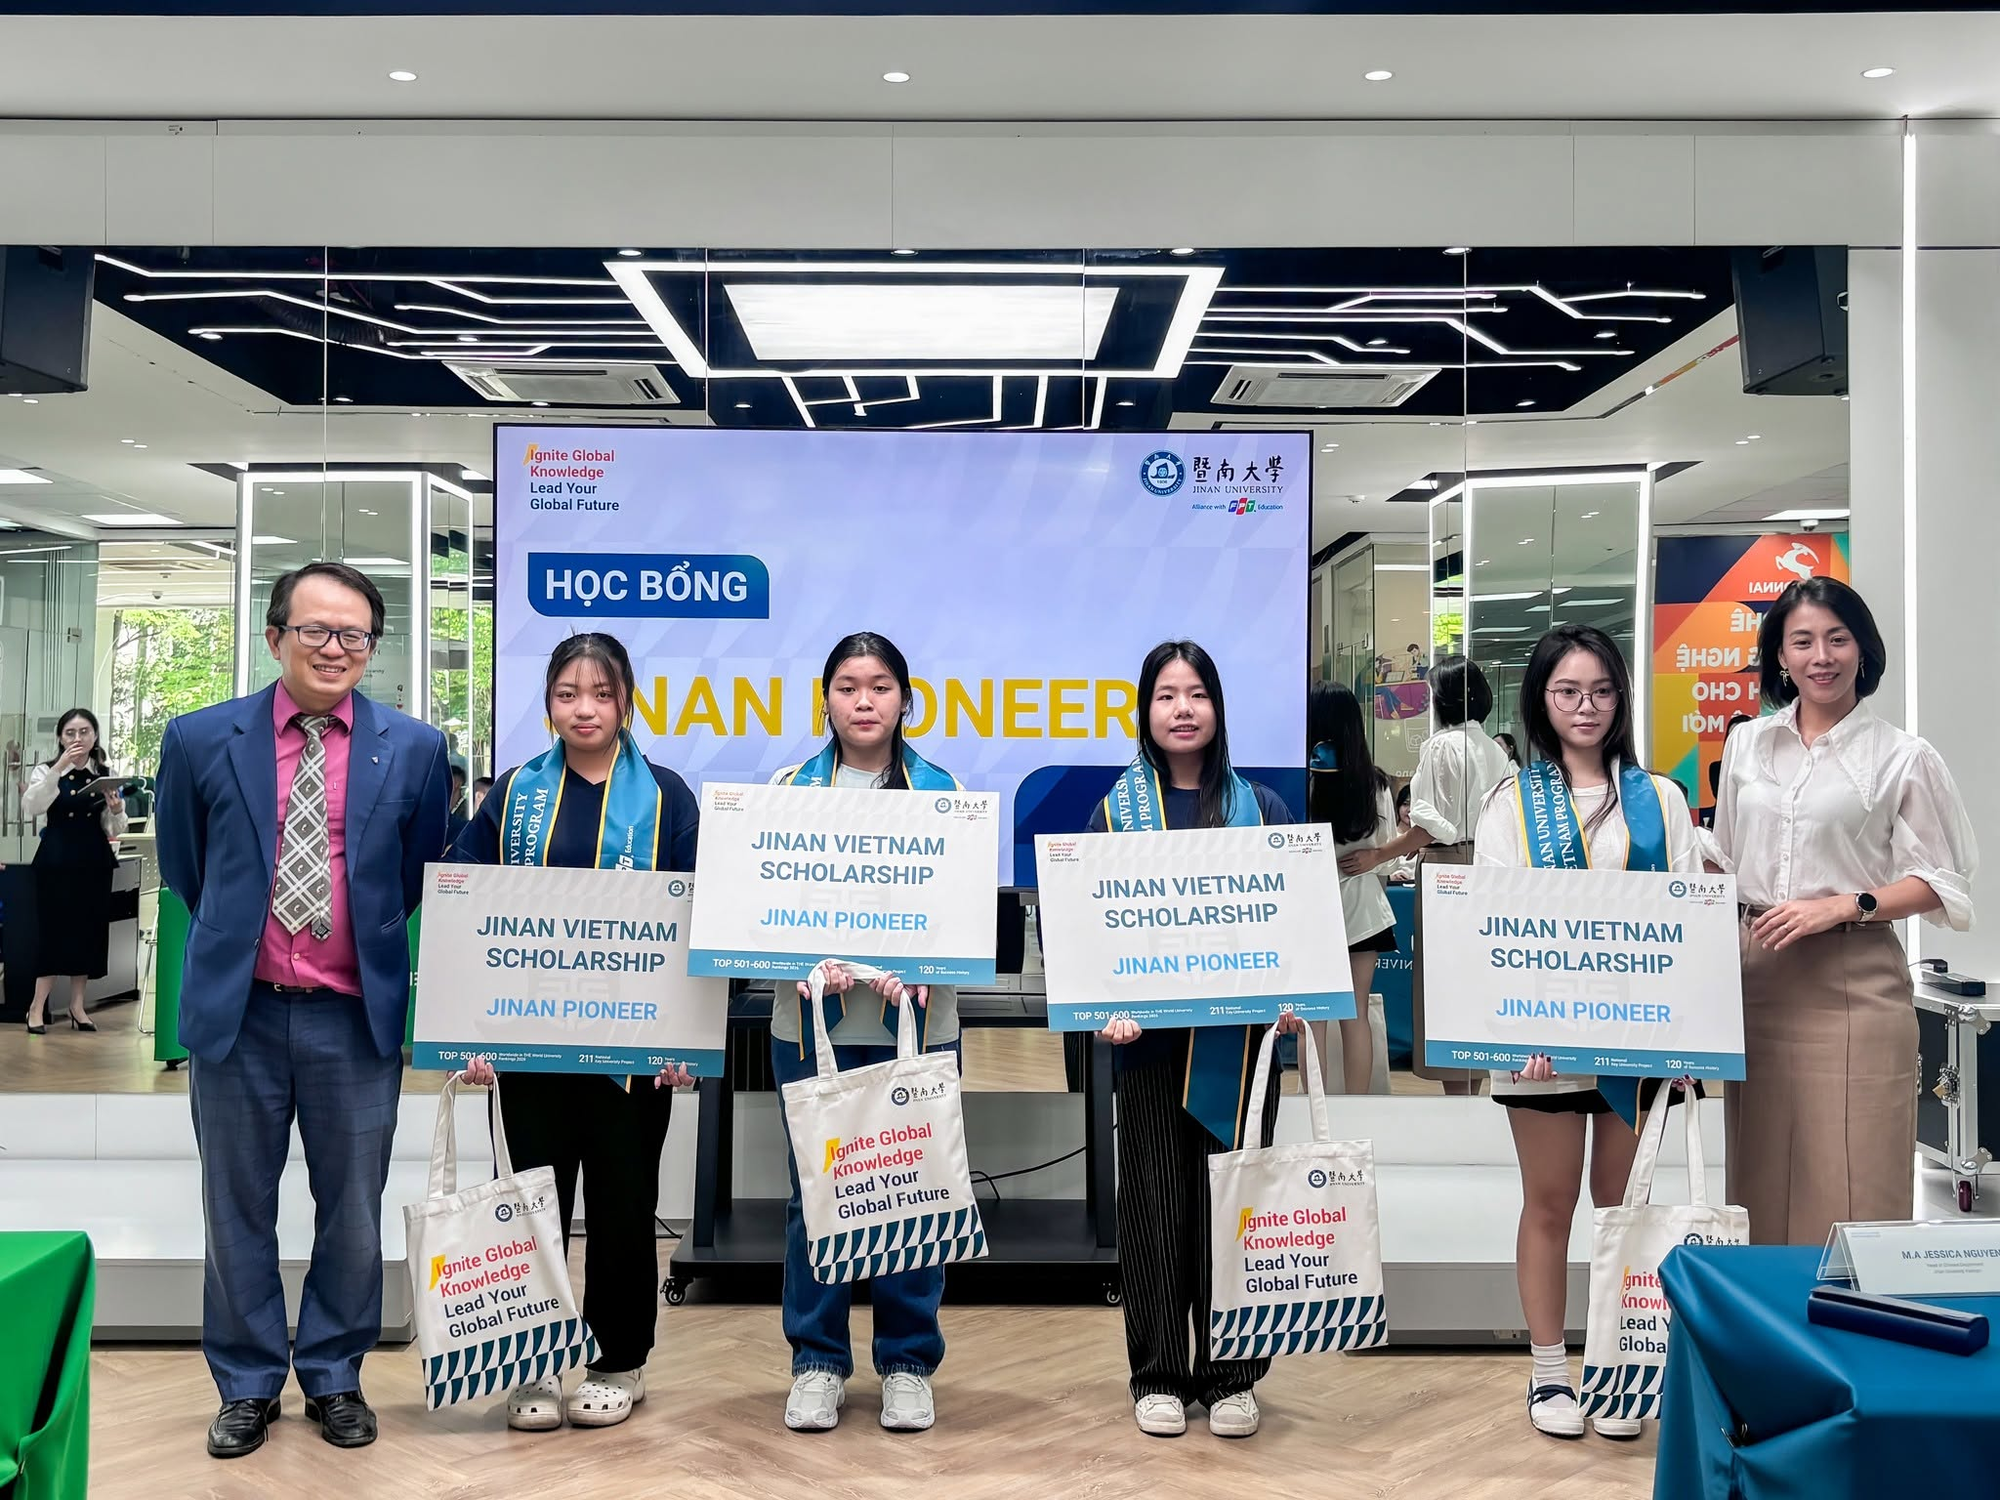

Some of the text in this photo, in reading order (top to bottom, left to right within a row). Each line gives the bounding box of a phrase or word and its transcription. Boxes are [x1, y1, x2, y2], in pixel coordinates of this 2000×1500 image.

[529, 449, 615, 463] Ignite Global
[530, 465, 604, 480] Knowledge
[1193, 455, 1284, 483] 暨南大學
[530, 482, 598, 494] Lead Your
[1192, 486, 1284, 494] JINAN UNIVERSITY
[530, 498, 620, 511] Global Future
[1228, 498, 1256, 515] FPT
[546, 560, 747, 606] HỌC BỔNG
[811, 677, 1137, 738] ONEER
[510, 792, 528, 865] IVERSITY
[524, 787, 549, 867] PROGRAM
[625, 825, 634, 853] Education
[751, 831, 945, 856] JINAN VIETNAM
[759, 861, 934, 885] SCHOLARSHIP
[1092, 873, 1286, 899] JINAN VIETNAM
[760, 909, 928, 931] JINAN PIONEER
[1104, 902, 1279, 928] SCHOLARSHIP
[476, 916, 677, 942] JINAN VIETNAM
[1478, 916, 1683, 943] JINAN VIETNAM
[485, 947, 666, 973] SCHOLARSHIP
[712, 958, 771, 970] TOP 501-600
[918, 965, 935, 975] 120
[1112, 951, 1280, 976] JINAN PIONEER
[1490, 947, 1674, 974] SCHOLARSHIP
[486, 998, 657, 1020] JINAN PIONEER
[1072, 1011, 1092, 1020] TOP
[1209, 1002, 1294, 1015] 211 120
[1496, 998, 1671, 1023] JINAN PIONEER
[438, 1051, 458, 1060] TOP
[578, 1054, 594, 1063] 211
[647, 1056, 663, 1065] 120
[1451, 1050, 1472, 1060] TOP
[1473, 1051, 1511, 1062] 501-600
[1594, 1056, 1682, 1069] 211 120
[830, 1122, 932, 1162] Ignite Global
[833, 1148, 924, 1180] Knowledge
[835, 1170, 919, 1199] Lead Your
[838, 1187, 950, 1220] Global Future
[1243, 1206, 1347, 1232] Ignite Global
[1243, 1230, 1335, 1250] Knowledge
[435, 1235, 538, 1279] Ignite Global
[1244, 1253, 1330, 1272] Lead Your
[1901, 1250, 1921, 1259] M.A
[1923, 1249, 1962, 1259] JESSICA
[440, 1262, 531, 1298] Knowledge
[1246, 1272, 1358, 1293] Global Future
[444, 1283, 528, 1318] Lead Your
[449, 1297, 560, 1338] Global Future
[1620, 1315, 1657, 1331] Lead
[1619, 1336, 1667, 1354] Globa
